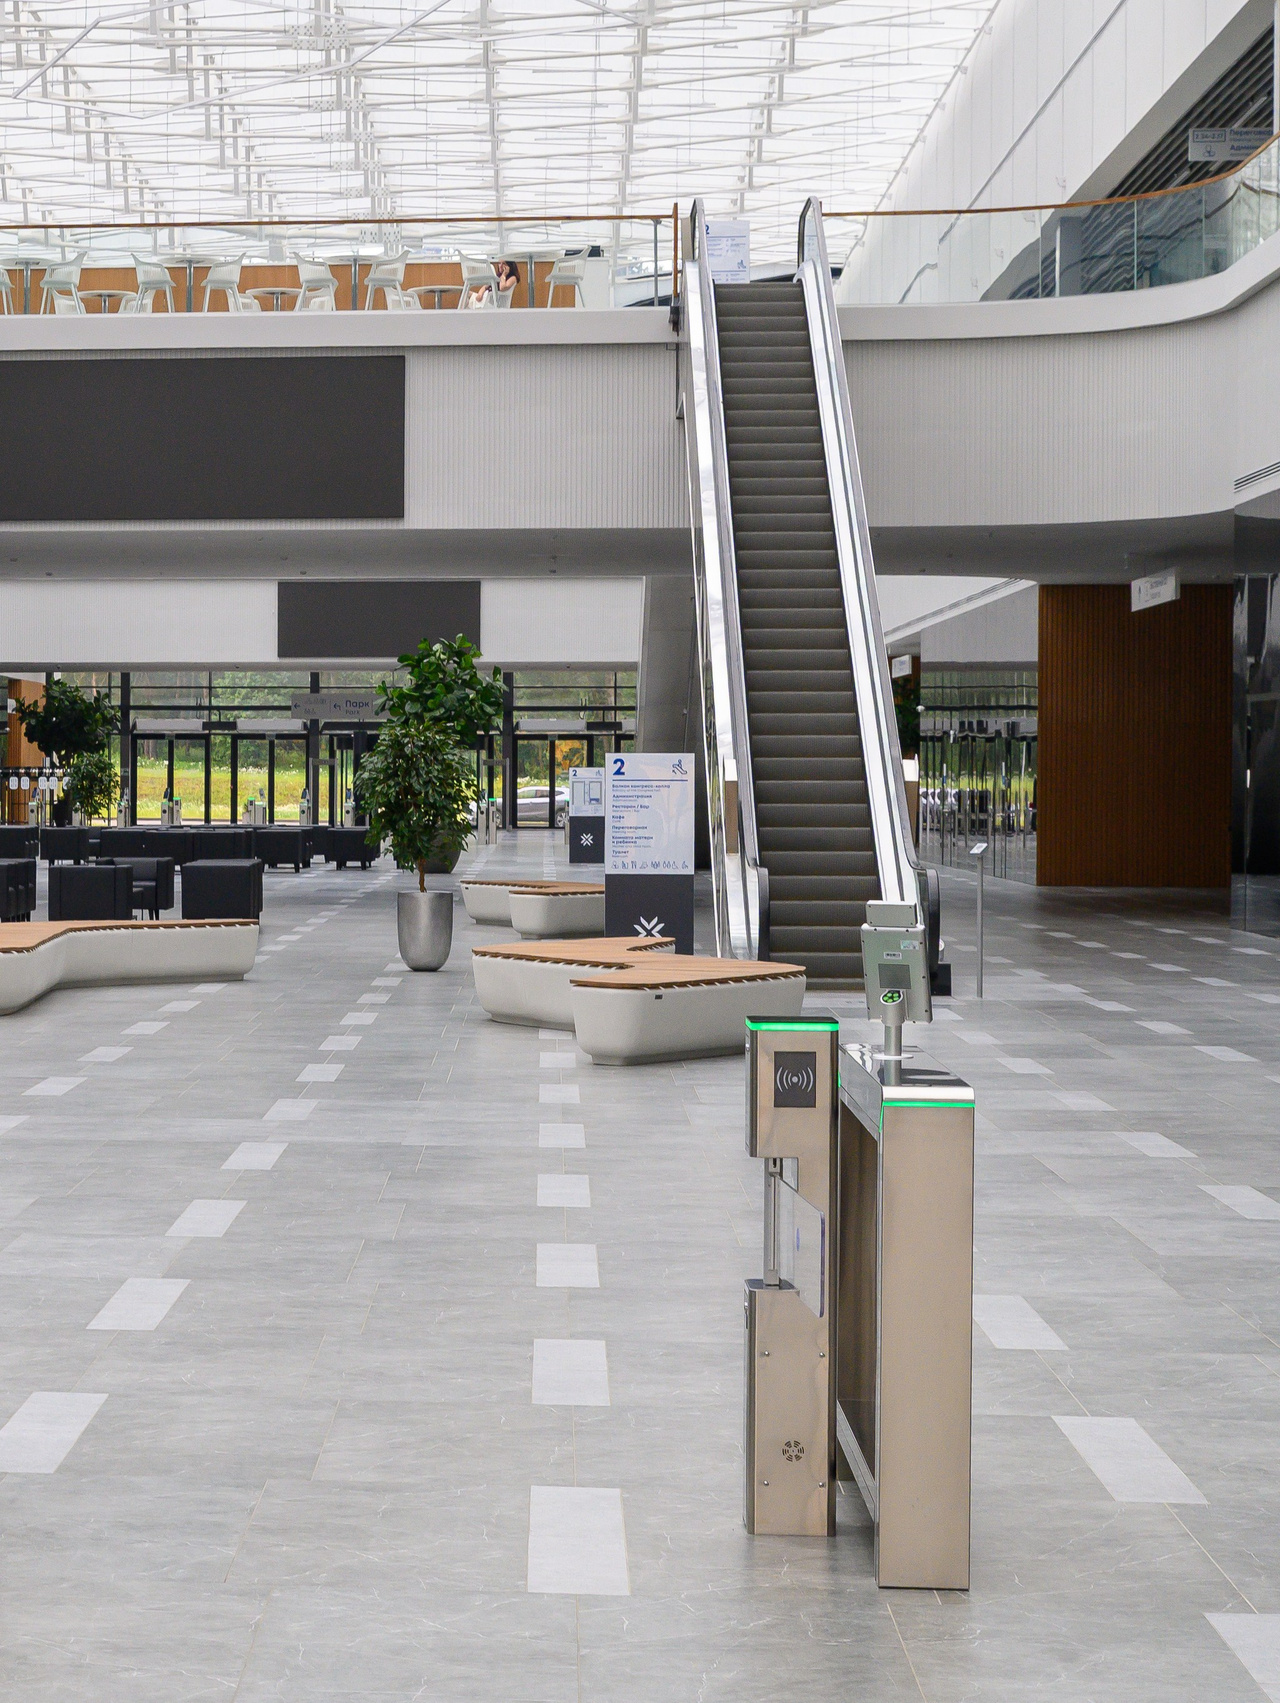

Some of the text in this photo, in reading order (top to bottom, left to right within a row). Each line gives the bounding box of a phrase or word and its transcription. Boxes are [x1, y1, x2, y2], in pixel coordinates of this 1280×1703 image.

[345, 700, 370, 709] Парк
[612, 758, 625, 776] 2
[572, 769, 578, 777] 2
